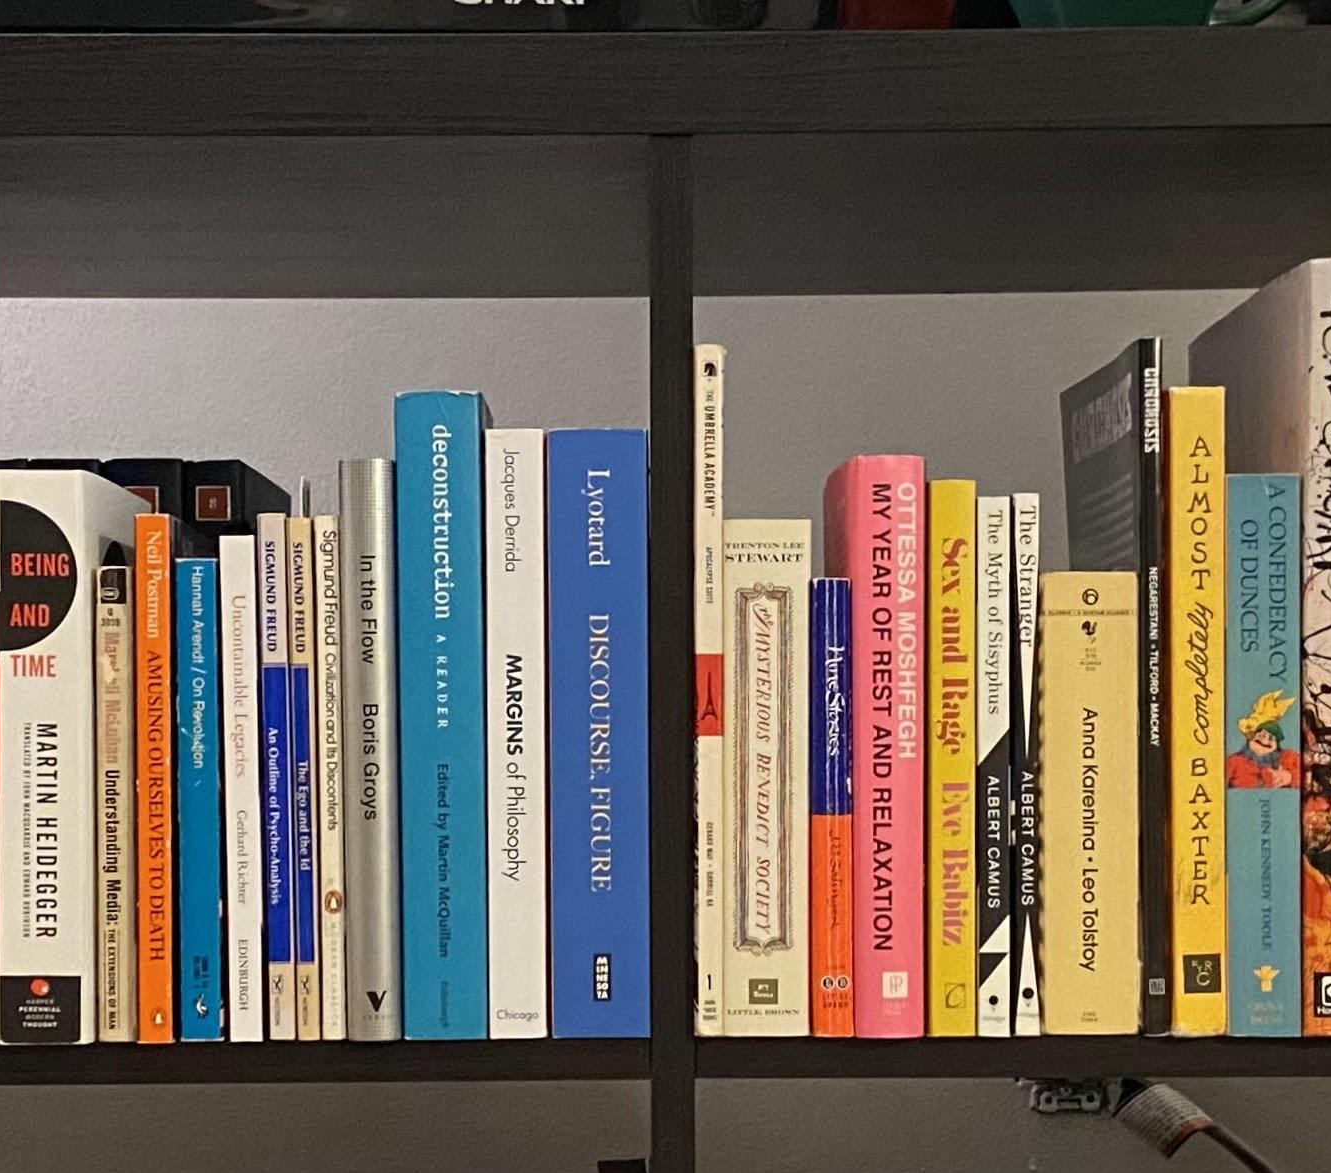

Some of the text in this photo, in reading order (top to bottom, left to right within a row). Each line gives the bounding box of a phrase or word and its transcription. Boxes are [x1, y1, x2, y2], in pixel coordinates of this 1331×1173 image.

[11, 554, 69, 577] BEING
[431, 424, 454, 619] deconstruction
[10, 603, 49, 627] AND
[10, 655, 56, 677] TIME
[581, 470, 611, 892] Lyotard DISCOURSE, FIGURE
[501, 654, 526, 882] MARGINS of Philosophy
[872, 484, 893, 950] MY YEAR OF REST AND RELAXATION
[36, 723, 58, 938] MARTIN HEIDEGGER
[102, 770, 122, 926] Understanding Media:
[1021, 771, 1034, 905] ALBERT CAMUS
[1079, 708, 1098, 972] Anna Karenina Leo Tolstoy
[1189, 758, 1212, 905] BAXTER
[496, 1009, 539, 1021] Chicago
